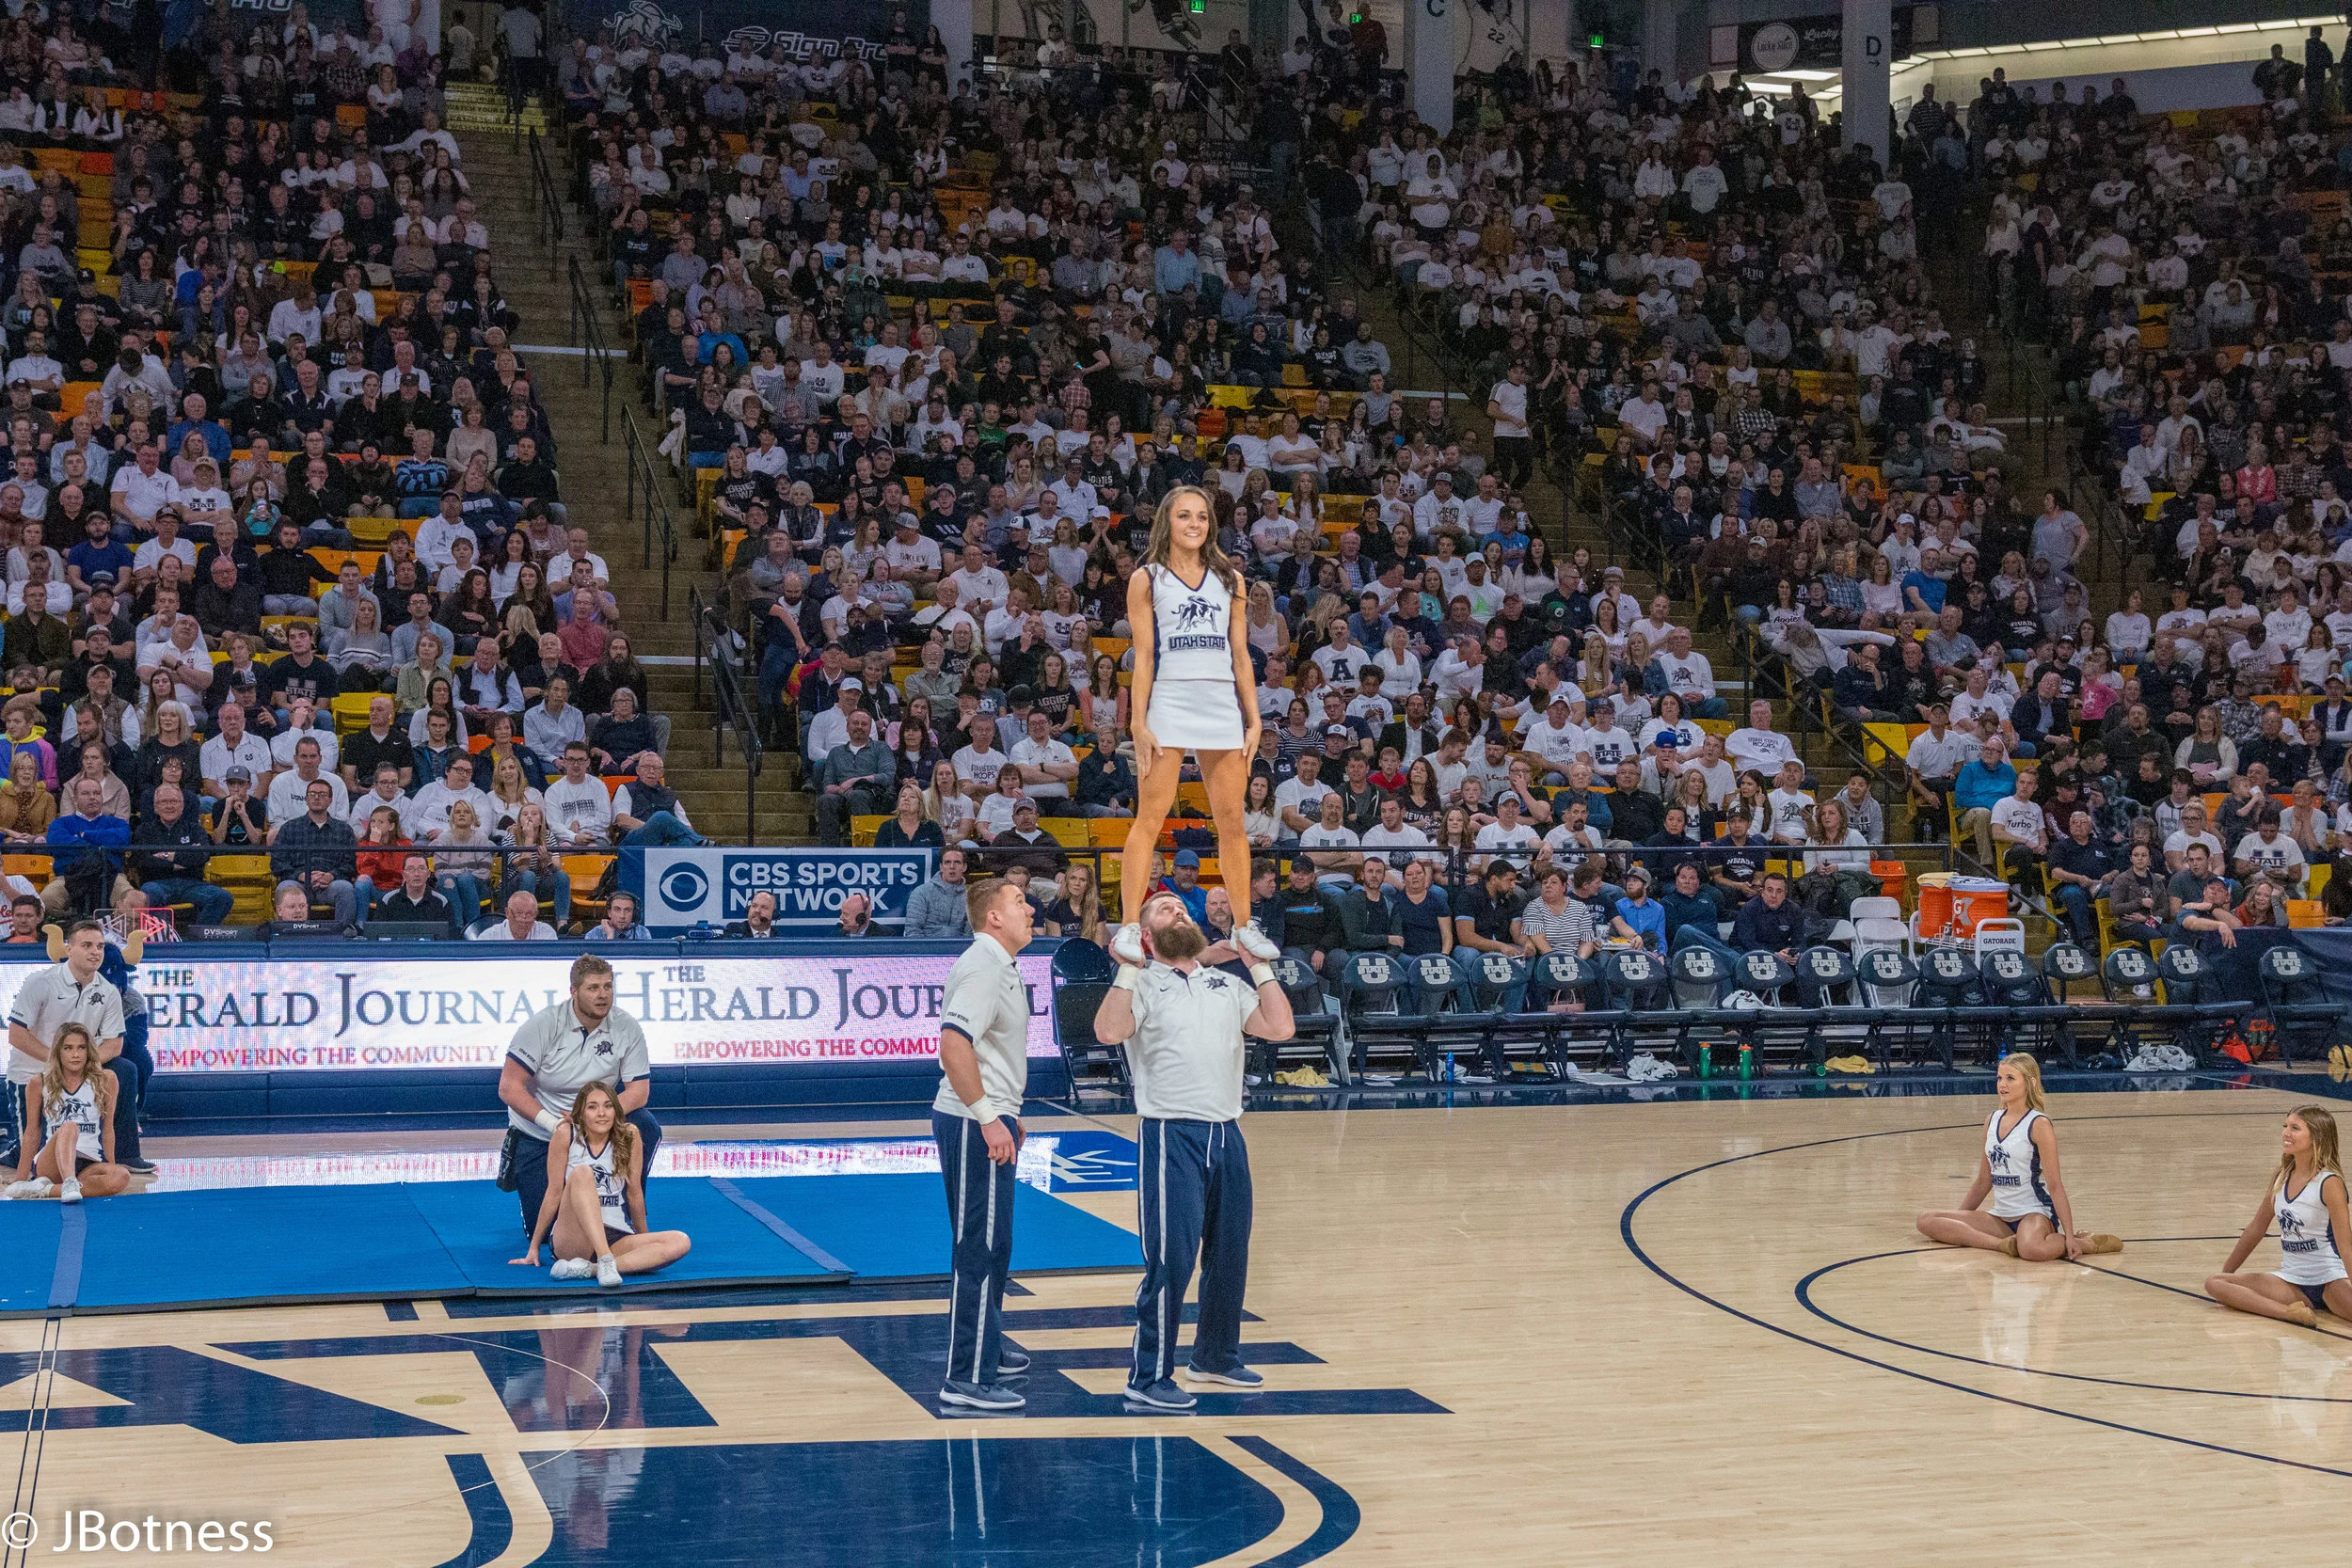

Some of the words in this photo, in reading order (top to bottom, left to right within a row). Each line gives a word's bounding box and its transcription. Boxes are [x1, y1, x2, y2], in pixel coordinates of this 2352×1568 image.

[1487, 27, 1505, 45] 22
[1591, 35, 1603, 45] EXIT
[1866, 36, 1882, 56] D
[1169, 637, 1199, 649] UTAH
[1199, 636, 1227, 650] STATE
[1329, 658, 1355, 681] A
[285, 687, 317, 699] STATE
[1595, 750, 1622, 759] STATE
[2007, 818, 2032, 830] Turbo
[2249, 857, 2287, 866] STATE
[729, 862, 790, 886] CBS
[797, 862, 918, 885] SPORTS
[729, 887, 889, 911] NTWOK
[1685, 959, 1715, 968] STATE
[1811, 959, 1841, 968] STATE
[1873, 961, 1902, 970] STATE
[1934, 960, 1963, 969] STATE
[1994, 961, 2023, 970] STATE
[2056, 956, 2084, 965] STATE
[2118, 960, 2146, 969] STATE
[2172, 957, 2199, 965] STATE
[2272, 958, 2301, 967] STATE
[1358, 965, 1390, 974] STATE
[1421, 966, 1451, 975] STATE
[1484, 965, 1512, 974] STATE
[1549, 963, 1579, 973] STATE
[1620, 962, 1650, 972] STATE
[1748, 962, 1778, 972] STATE
[148, 969, 195, 987] THE
[663, 965, 706, 983] THE
[148, 991, 321, 1029] ERALD
[614, 970, 819, 1023] HERALD
[155, 1046, 308, 1068] EMPOWERING
[312, 1045, 357, 1065] THE
[358, 1045, 499, 1065] COMMUNITY
[675, 1038, 812, 1060] EMPOWERING
[817, 1037, 857, 1058] THE
[859, 1035, 941, 1057] COMMU
[1997, 1175, 2020, 1186] STATE
[2289, 1238, 2318, 1252] STATE
